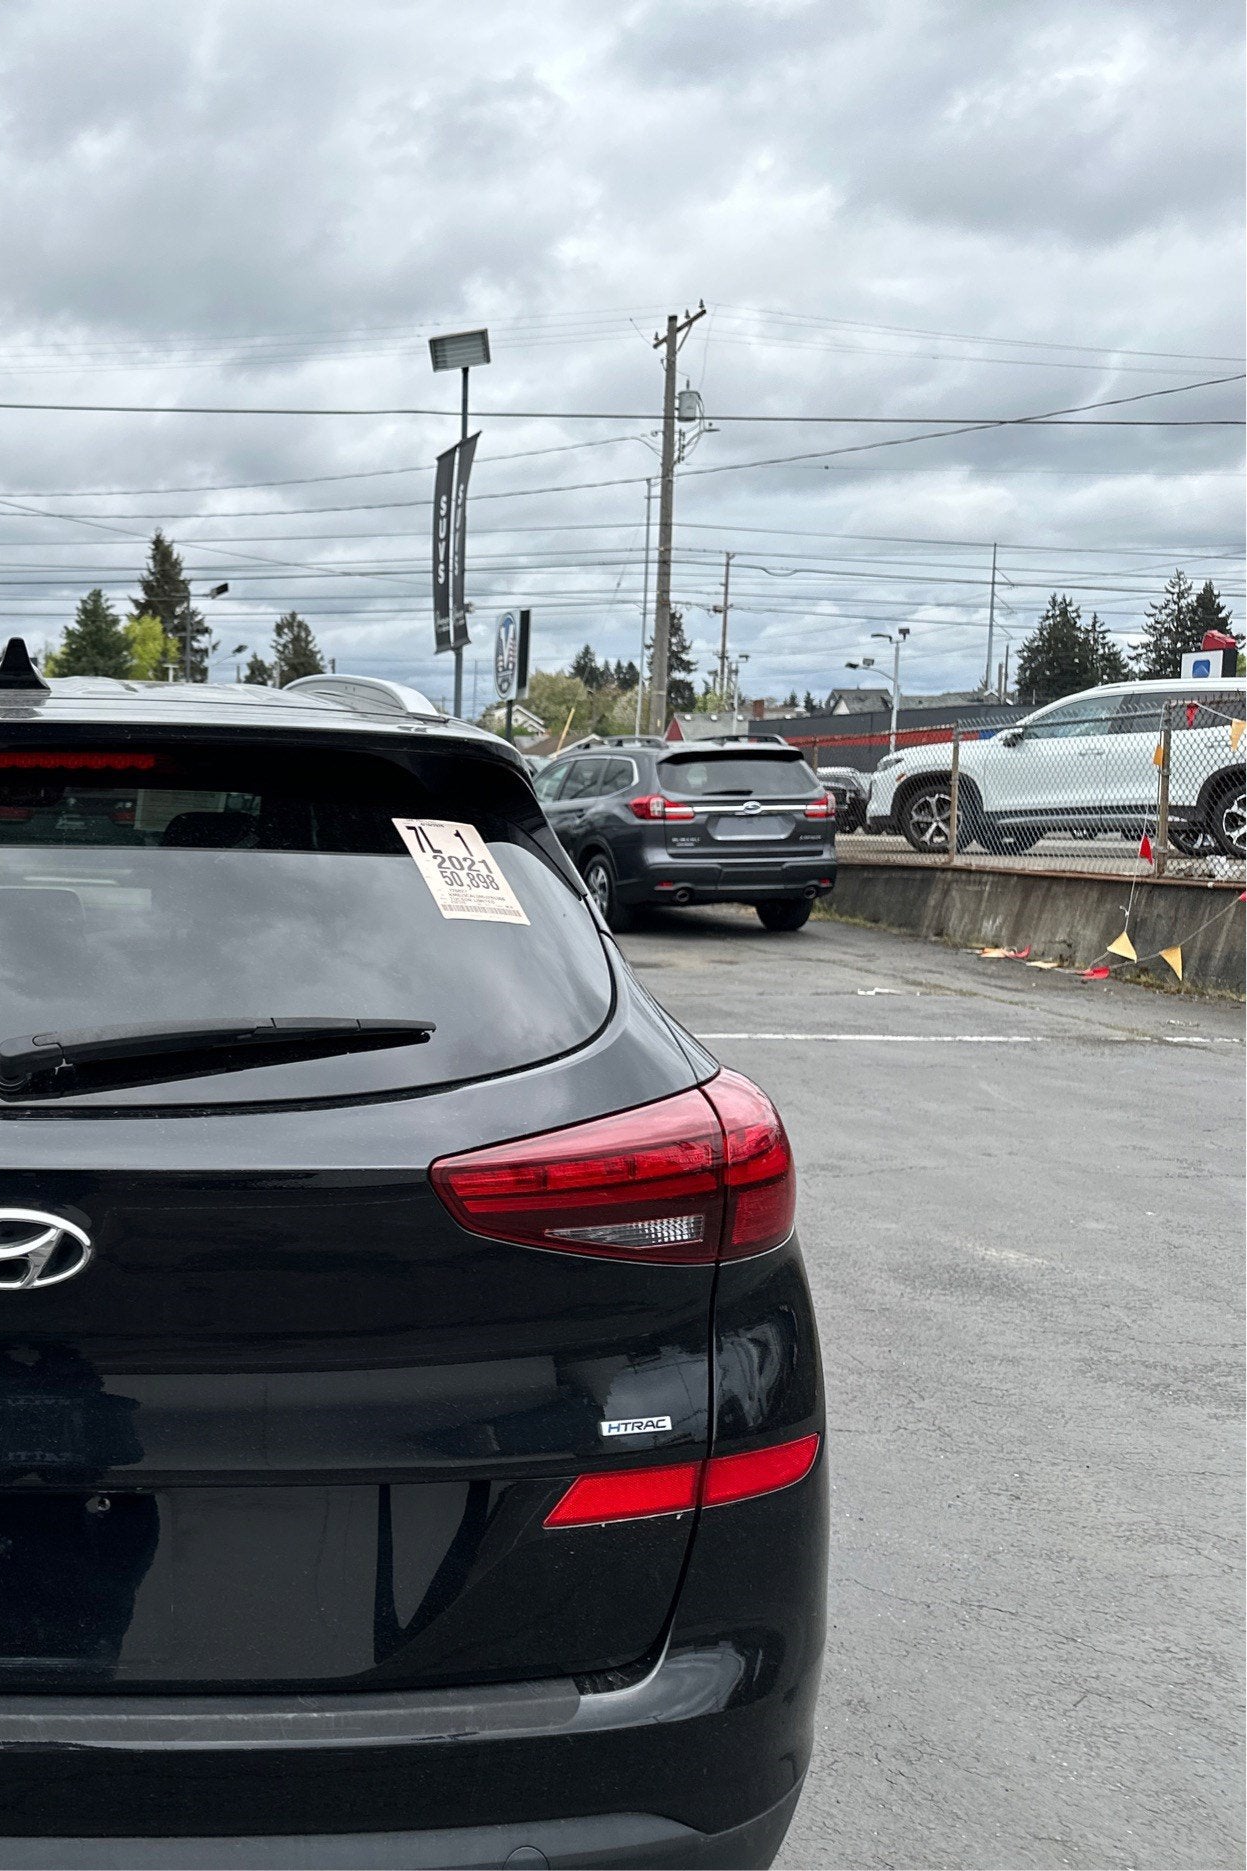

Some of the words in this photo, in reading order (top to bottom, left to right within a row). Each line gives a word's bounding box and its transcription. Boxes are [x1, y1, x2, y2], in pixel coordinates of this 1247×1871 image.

[437, 494, 448, 585] SUVS
[432, 854, 494, 875] 2021
[439, 870, 500, 891] 50,898
[608, 1419, 667, 1433] HTRAC
